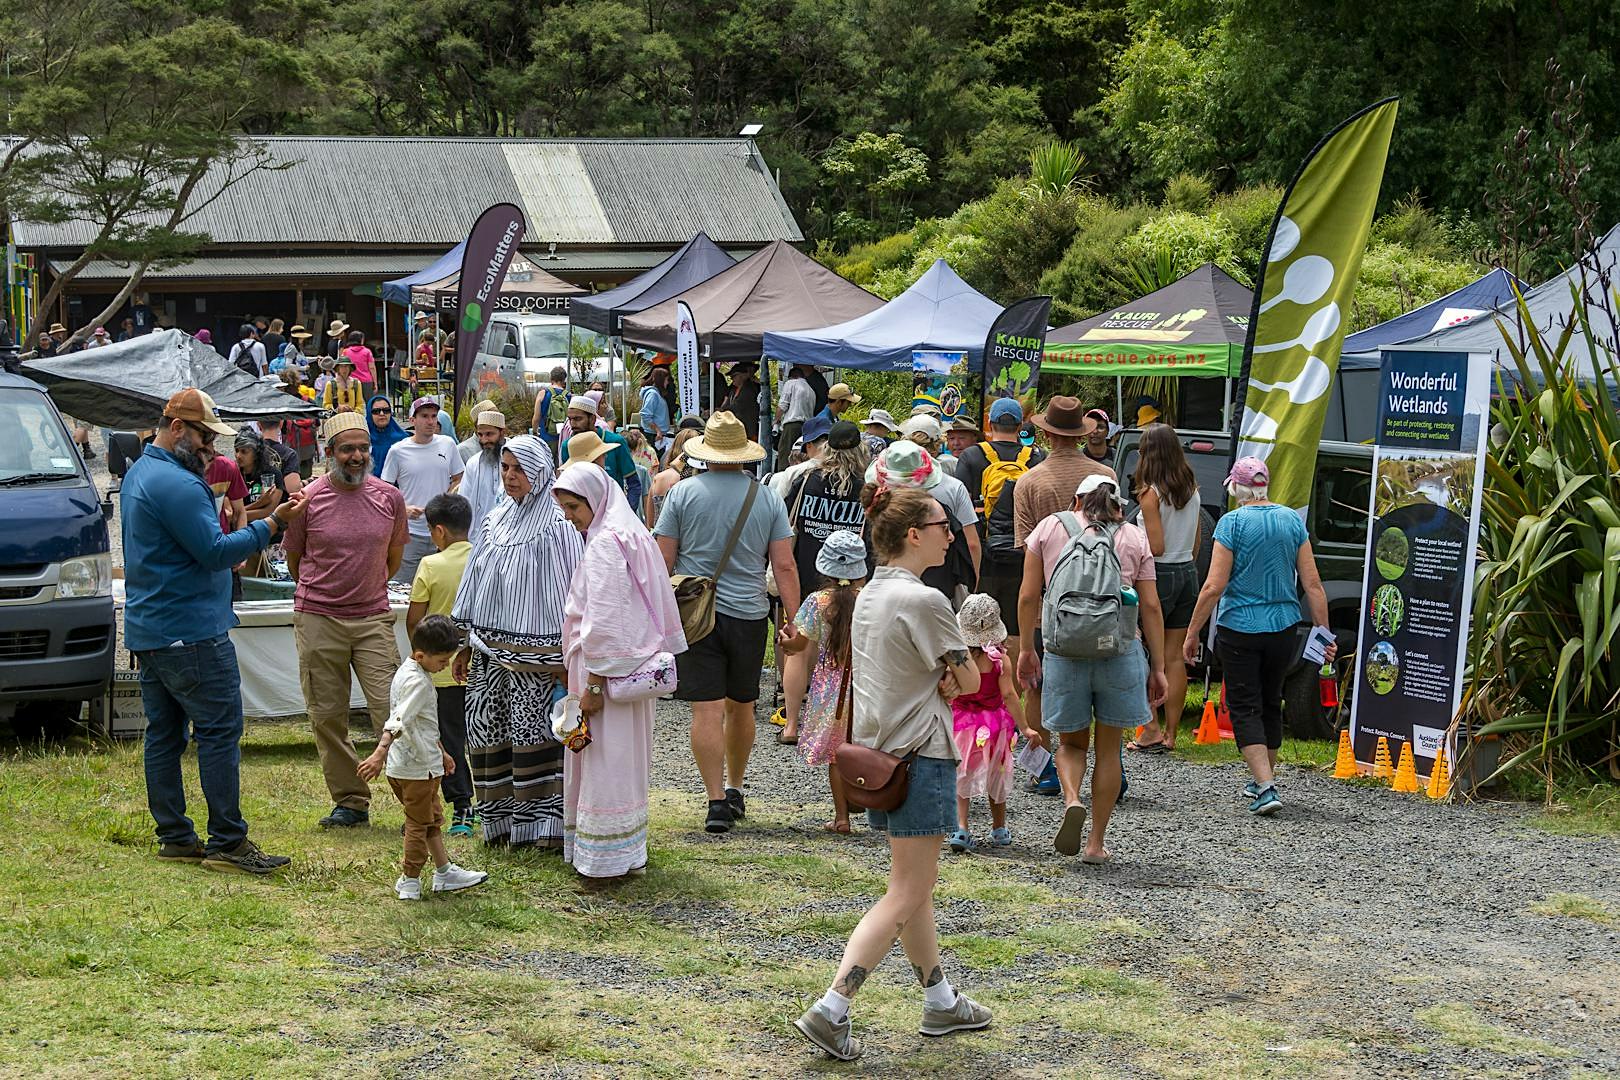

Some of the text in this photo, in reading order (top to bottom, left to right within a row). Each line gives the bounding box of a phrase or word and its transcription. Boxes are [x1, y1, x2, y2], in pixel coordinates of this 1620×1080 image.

[477, 220, 519, 302] EcoMatters
[525, 296, 570, 309] COFFE
[1110, 311, 1160, 321] KAURI
[1100, 320, 1153, 329] RESCUE
[996, 332, 1041, 350] KAURI
[994, 345, 1040, 363] RESCUE
[1041, 350, 1206, 366] aurirescue.org.nz
[1390, 371, 1457, 391] Wonderful
[1389, 394, 1448, 415] Wetlands
[1386, 418, 1392, 426] Be
[1433, 422, 1454, 431] restoring
[1386, 429, 1394, 437] and
[1394, 431, 1419, 440] connecting
[1428, 432, 1449, 440] wetlands
[804, 519, 862, 533] RUNNING BECAUSE
[1419, 734, 1437, 743] Auckland
